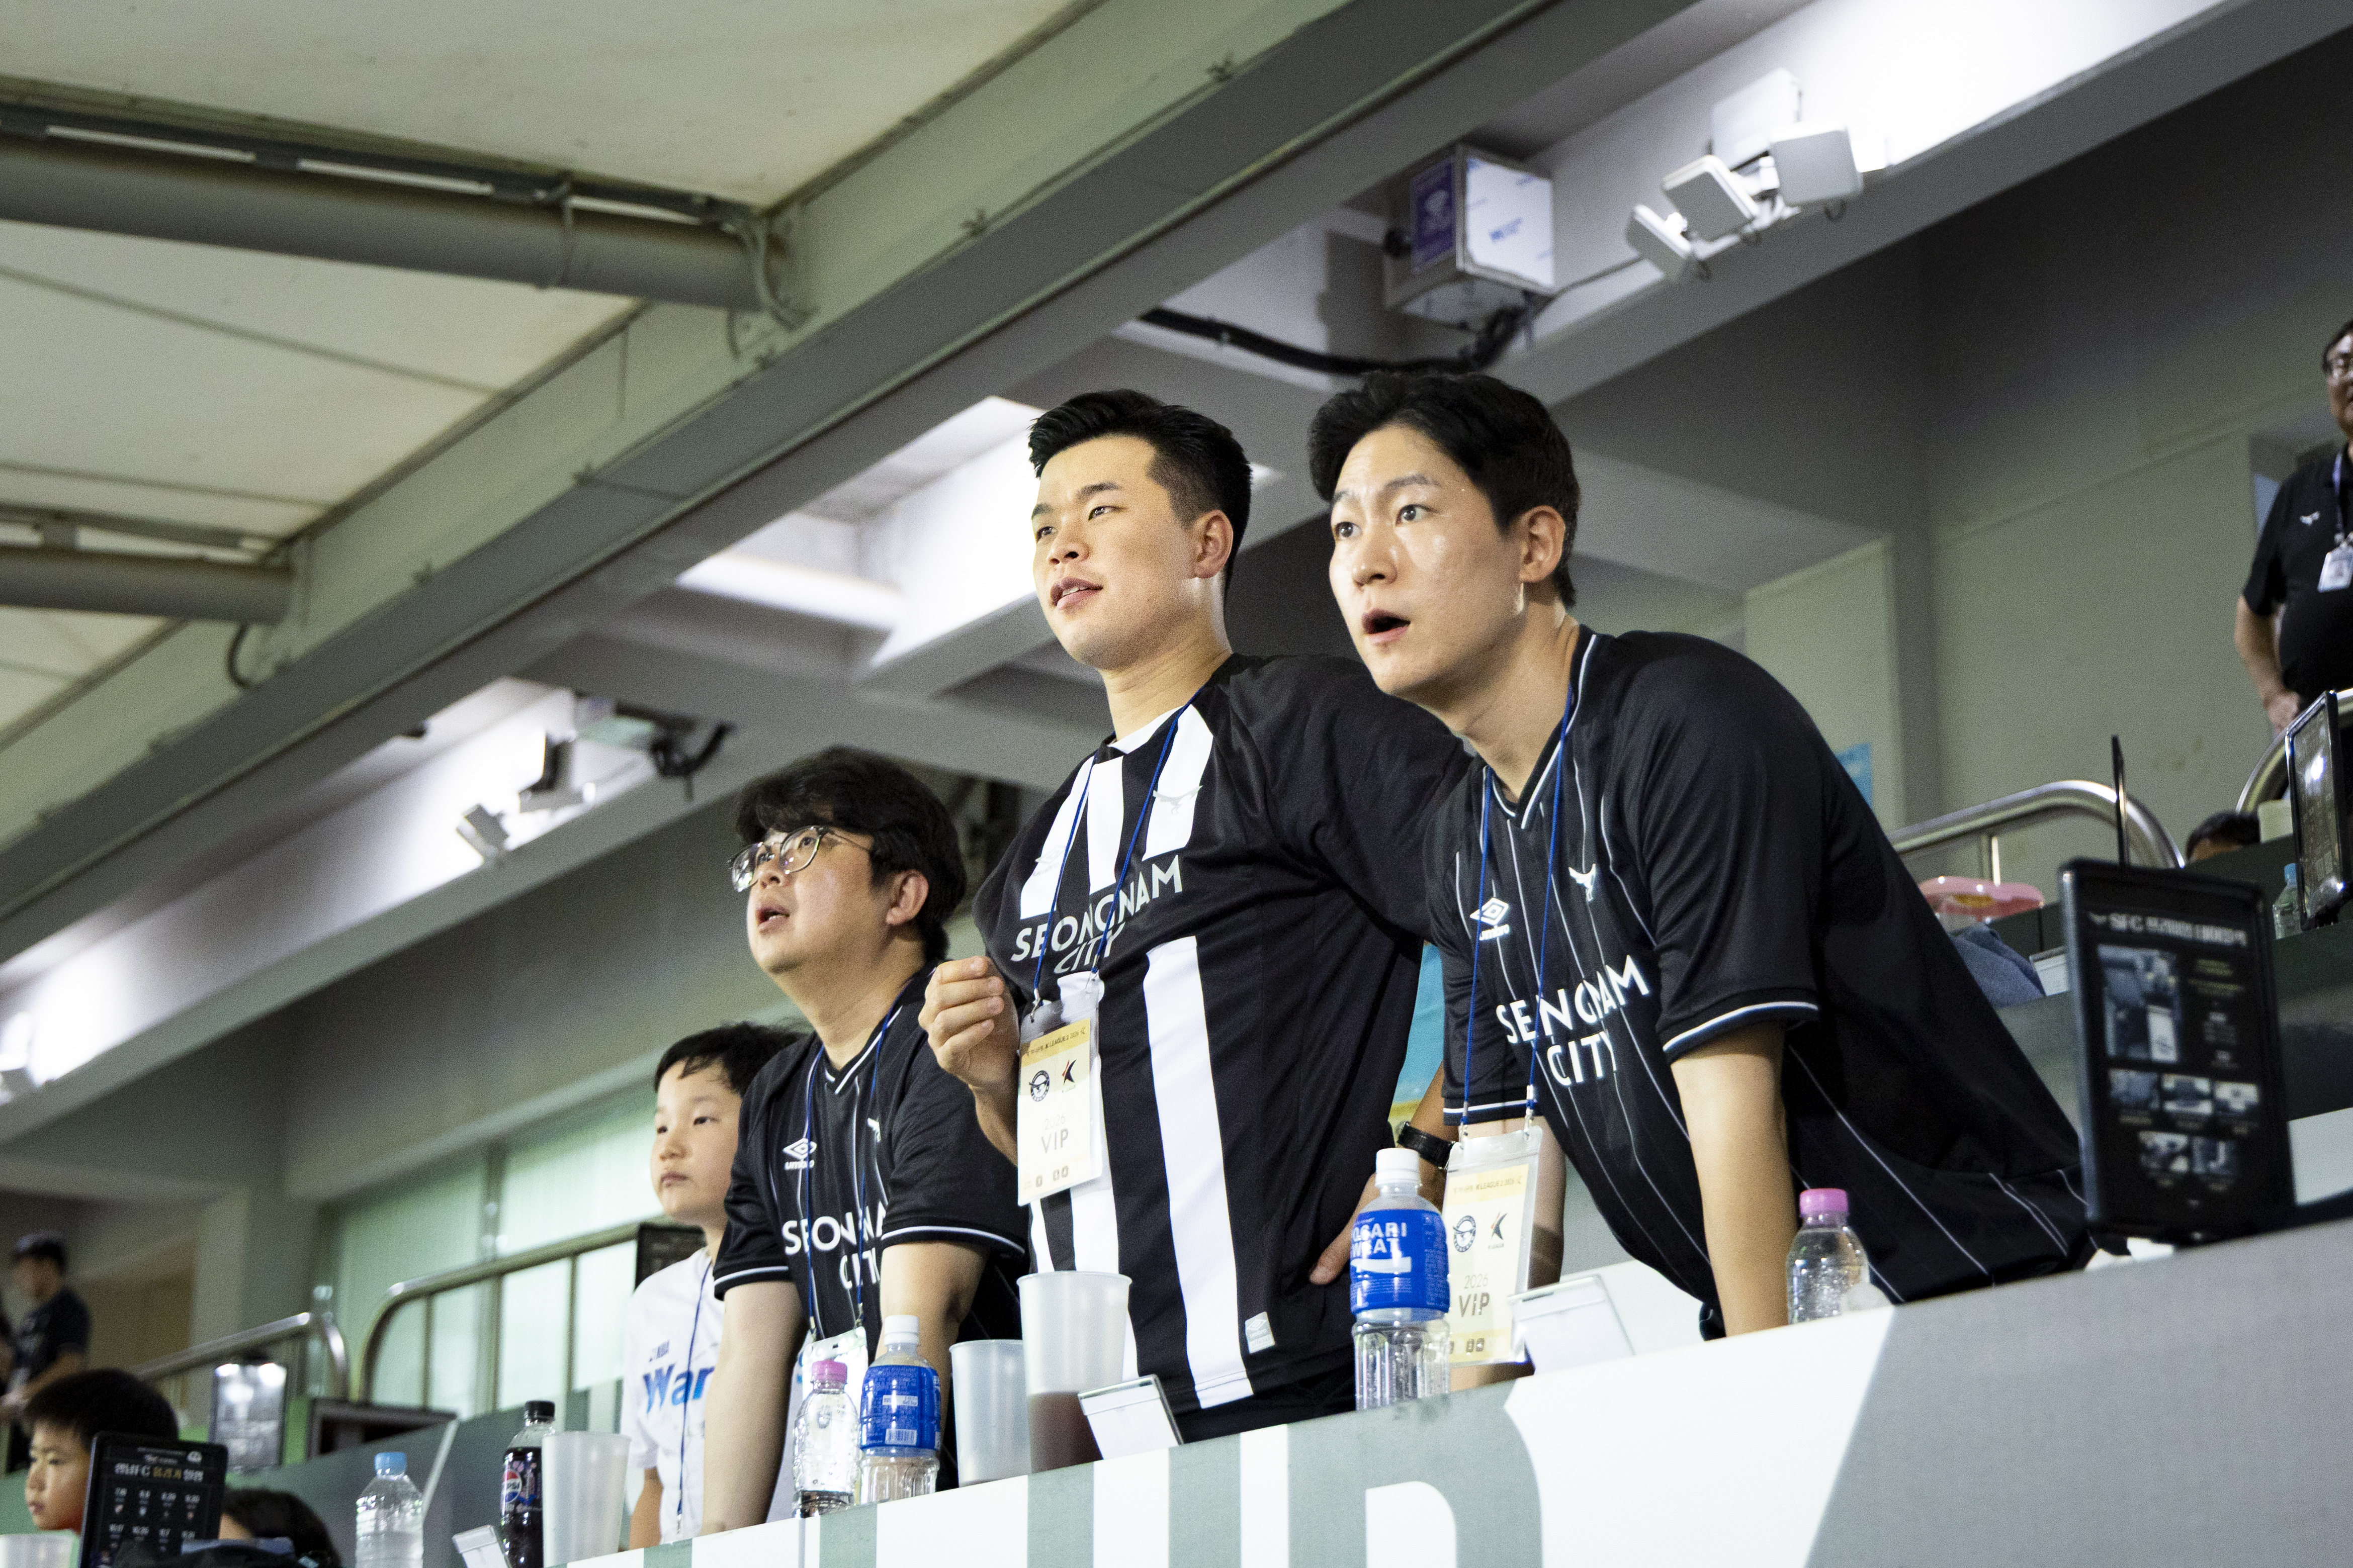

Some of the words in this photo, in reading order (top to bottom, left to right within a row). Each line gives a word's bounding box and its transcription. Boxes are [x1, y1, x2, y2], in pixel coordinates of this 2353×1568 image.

[1054, 922, 1125, 974] CITY
[1044, 1112, 1066, 1130] 2026
[1041, 1128, 1069, 1153] VIP
[784, 1159, 815, 1170] umbo
[1480, 1180, 1499, 1189] LEAGUE
[1464, 1273, 1489, 1289] 2026
[1458, 1292, 1490, 1318] VIP
[643, 1363, 715, 1414] War
